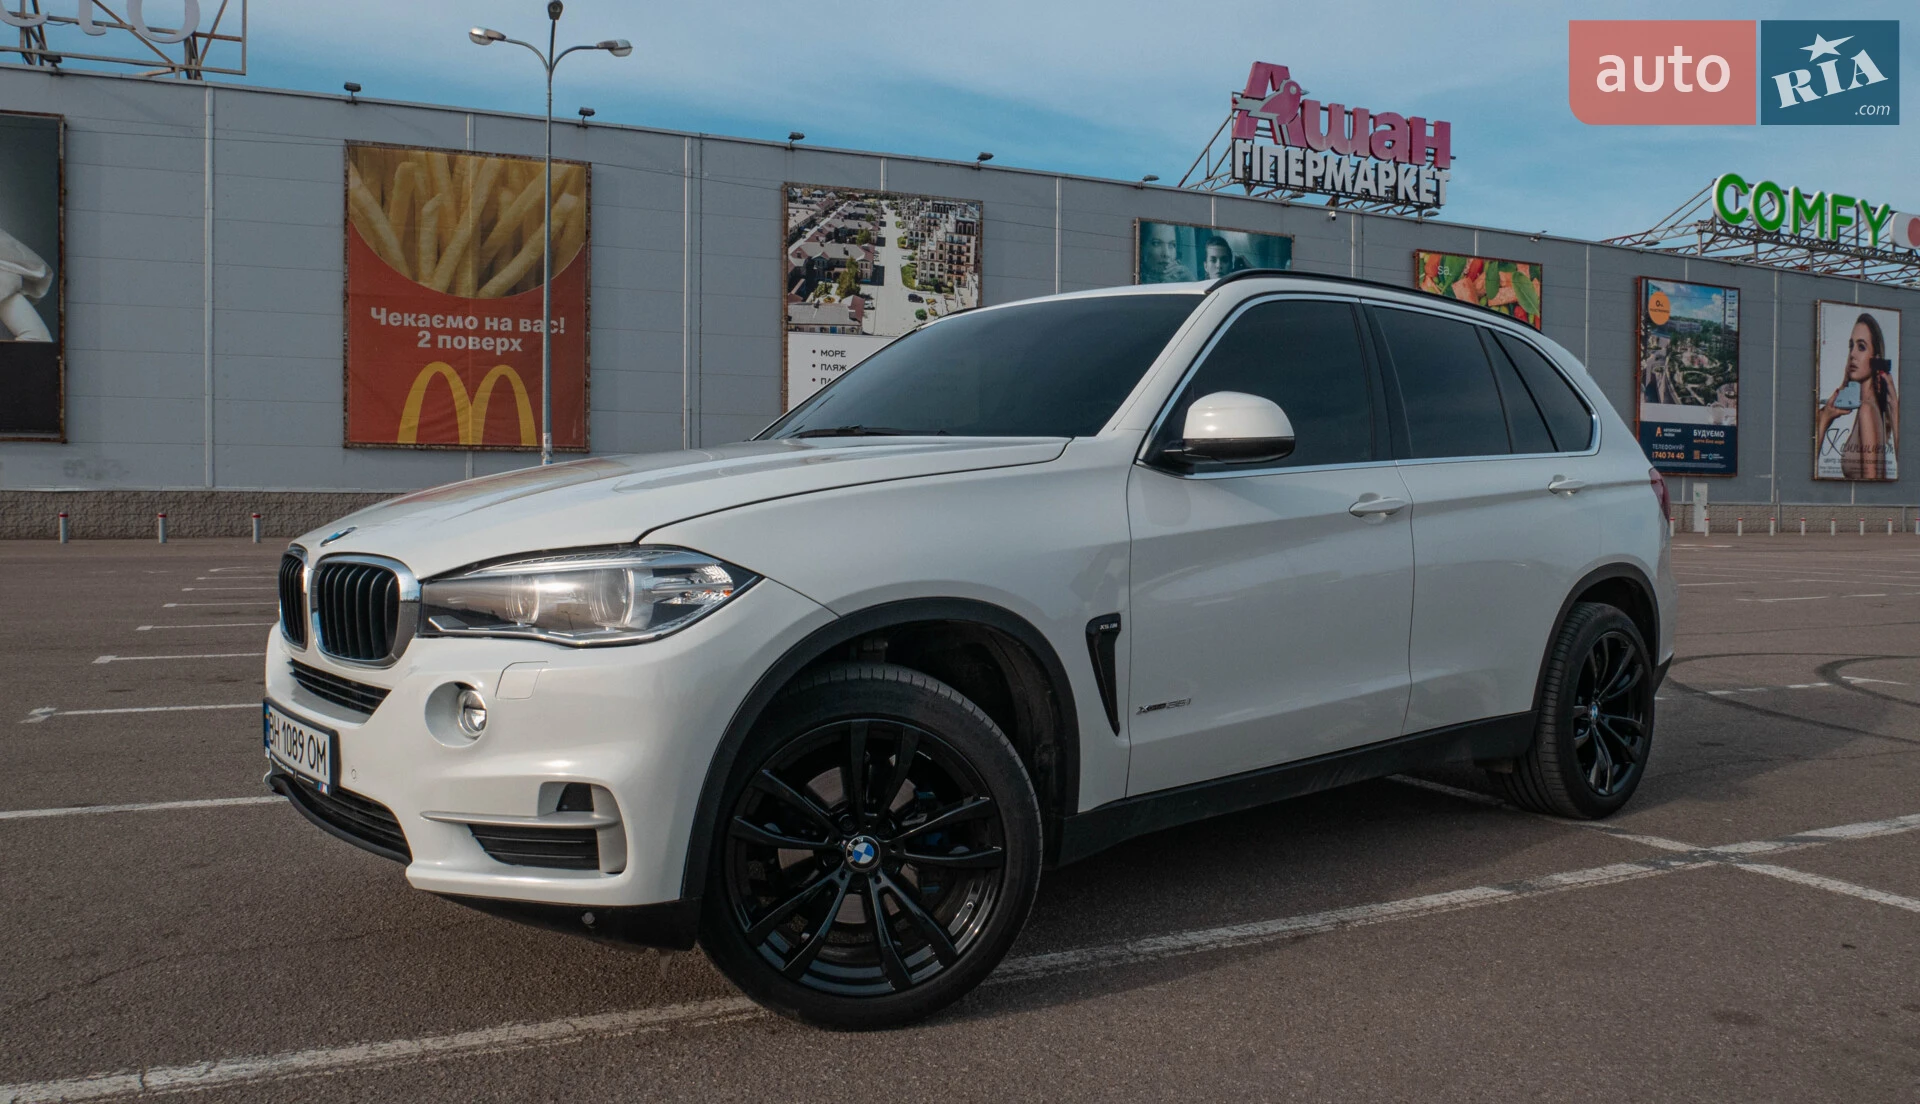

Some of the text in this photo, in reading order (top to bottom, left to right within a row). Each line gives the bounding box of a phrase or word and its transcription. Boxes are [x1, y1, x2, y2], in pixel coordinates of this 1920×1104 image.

[1231, 140, 1450, 207] ГІПЕРМАРКЕТ
[1712, 172, 1891, 248] COMFY
[370, 306, 565, 334] Чекаємо на вас!
[417, 330, 523, 356] 2 поверх
[820, 349, 847, 358] МОРЕ
[820, 363, 848, 372] ПЛЯЖ
[1693, 429, 1725, 438] БУДУЄМО
[282, 721, 305, 764] 1089
[308, 734, 326, 776] OM
